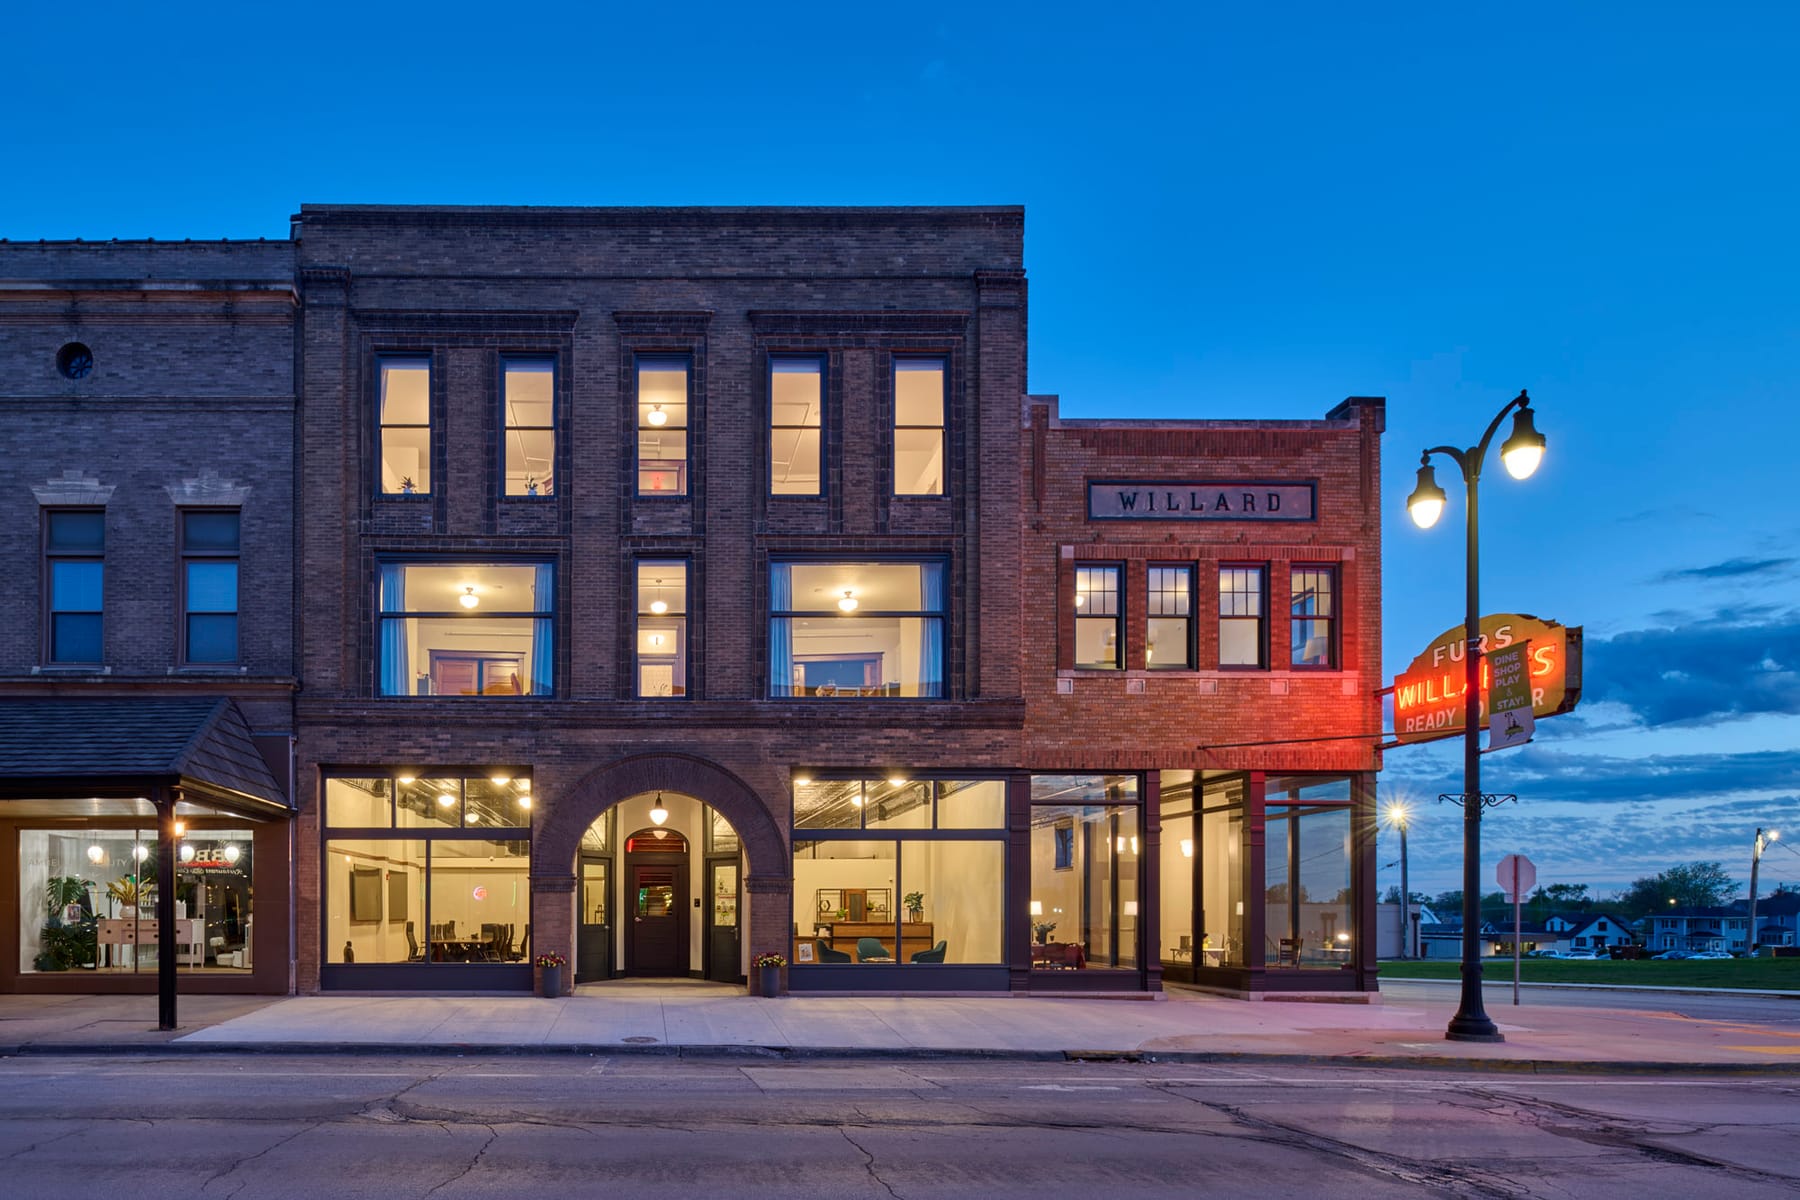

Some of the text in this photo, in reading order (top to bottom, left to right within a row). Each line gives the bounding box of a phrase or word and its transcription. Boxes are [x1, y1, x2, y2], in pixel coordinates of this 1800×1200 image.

[1118, 491, 1281, 512] WILLARD
[1433, 625, 1513, 668] FURS
[1495, 652, 1519, 666] DINE
[1494, 662, 1521, 677] SHOP
[1495, 674, 1520, 688] PLAY
[1496, 695, 1524, 710] STAY!
[1406, 707, 1456, 733] READY
